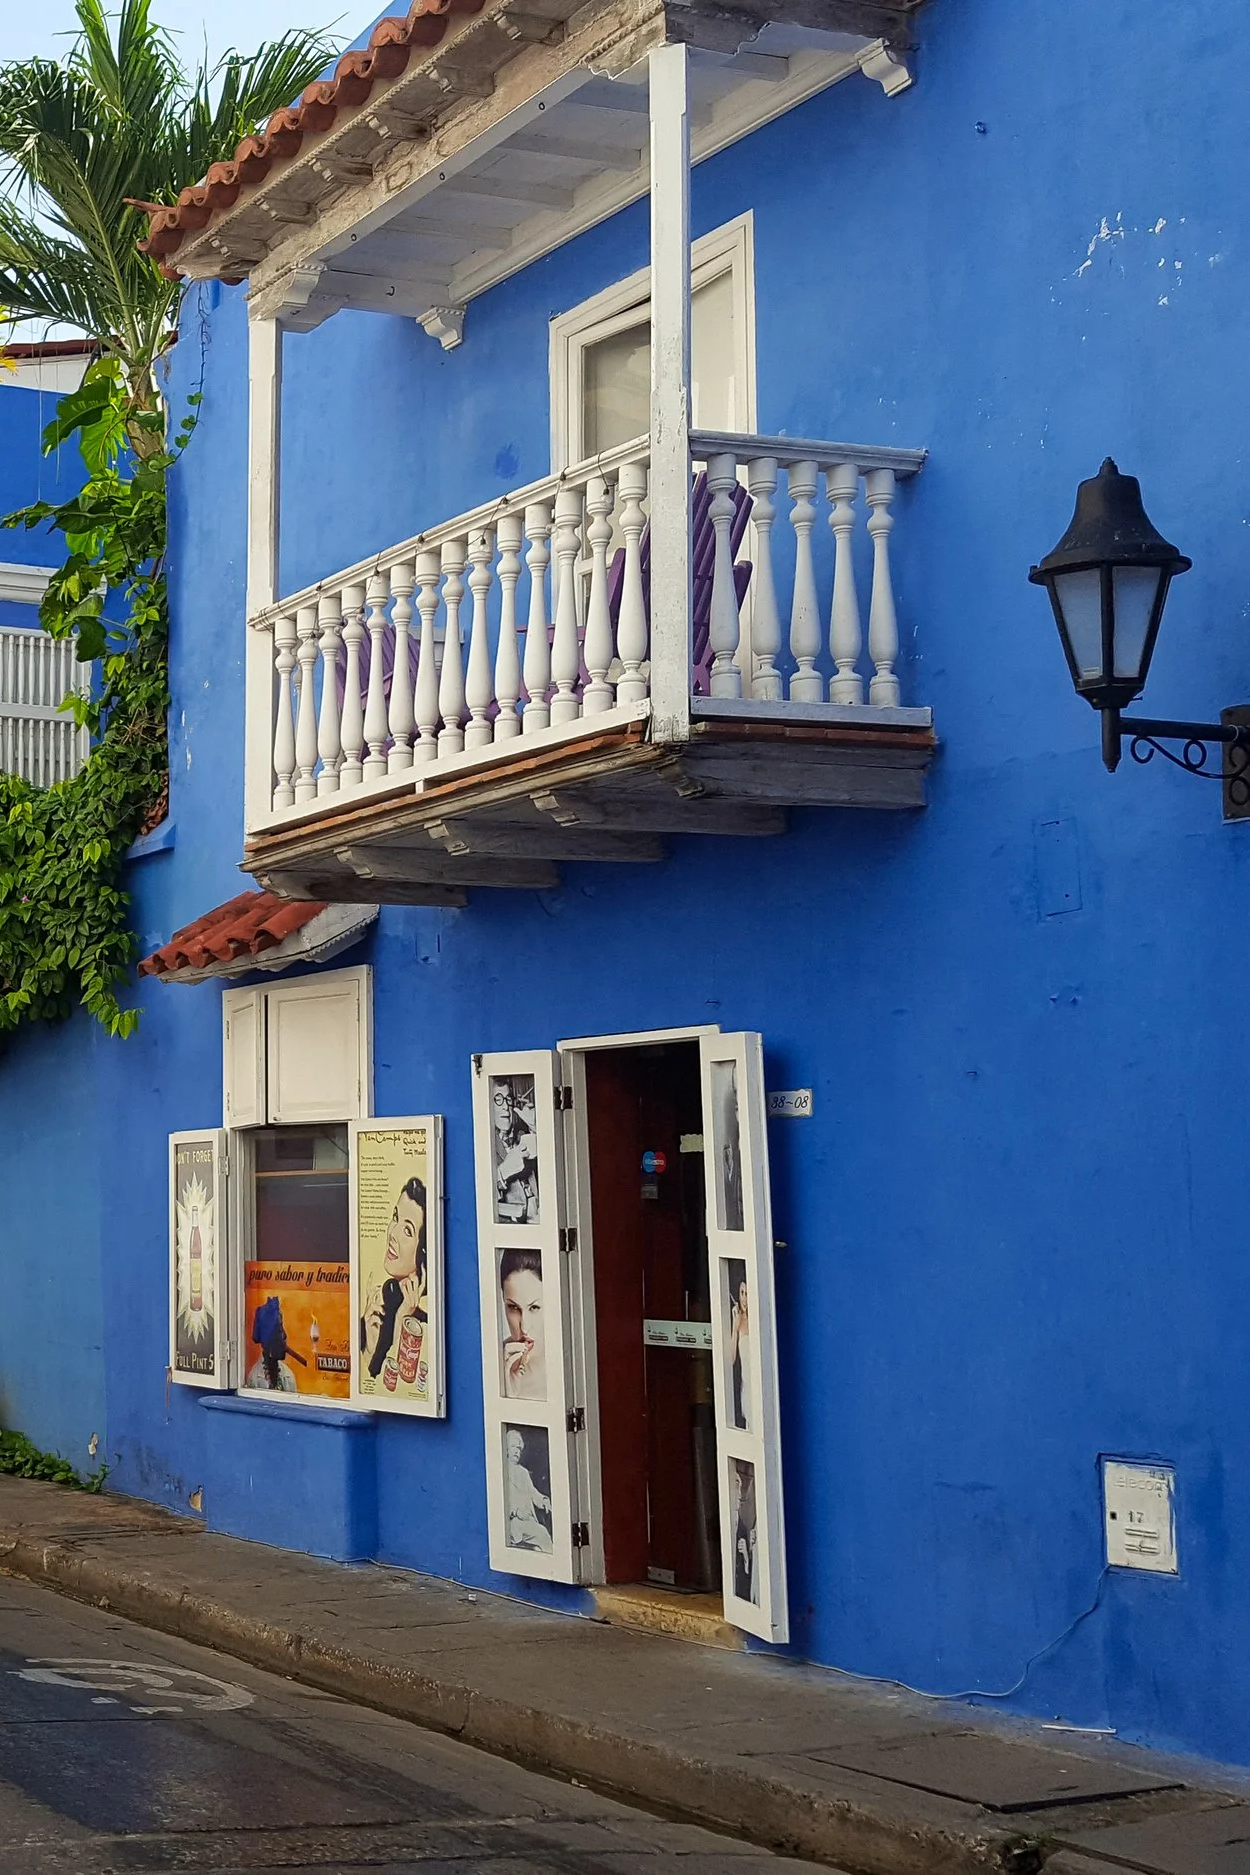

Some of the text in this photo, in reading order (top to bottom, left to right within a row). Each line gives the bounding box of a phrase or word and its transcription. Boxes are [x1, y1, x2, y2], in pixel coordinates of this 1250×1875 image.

[275, 1265, 304, 1282] sabor
[306, 1270, 314, 1287] y
[318, 1356, 348, 1369] TABACO
[1128, 1510, 1144, 1523] 17
